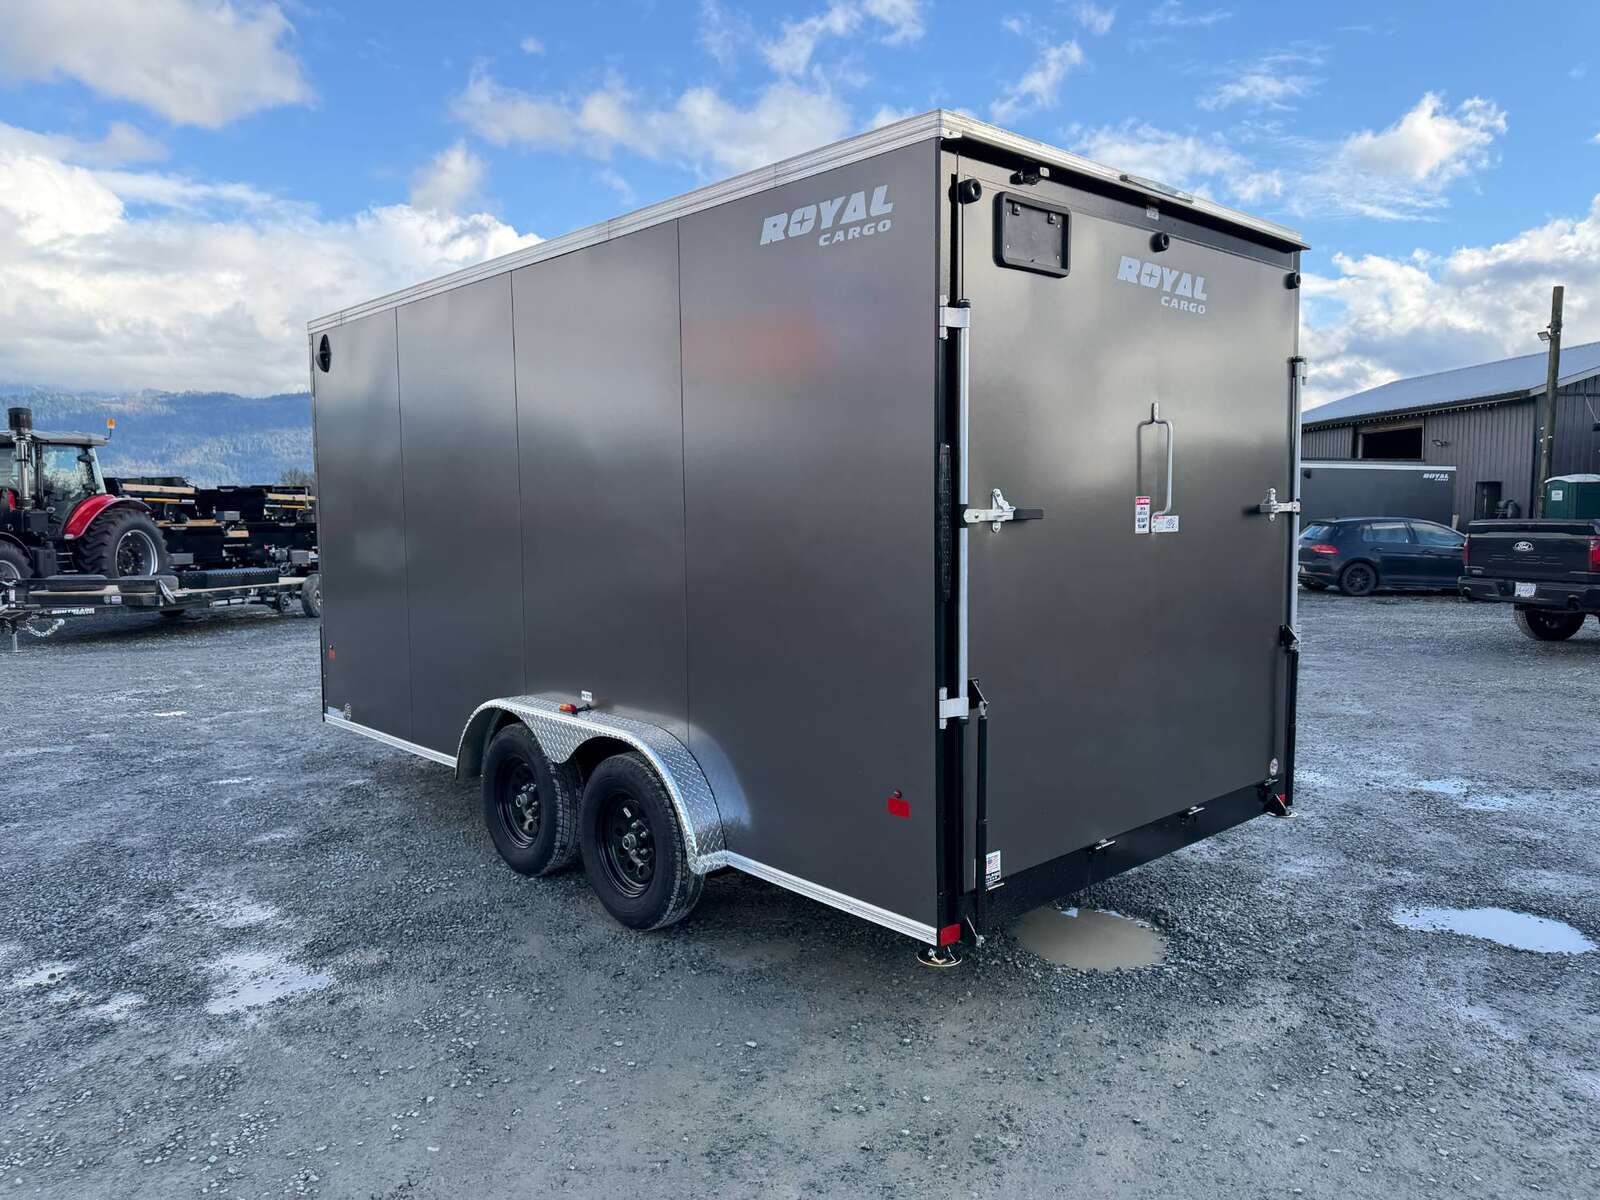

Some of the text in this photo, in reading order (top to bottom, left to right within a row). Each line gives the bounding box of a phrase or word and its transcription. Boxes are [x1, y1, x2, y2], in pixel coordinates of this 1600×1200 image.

[760, 184, 894, 246] ROYAL
[818, 219, 892, 247] CARGO
[1117, 255, 1208, 301] ROYAL
[1160, 296, 1206, 315] CARGO
